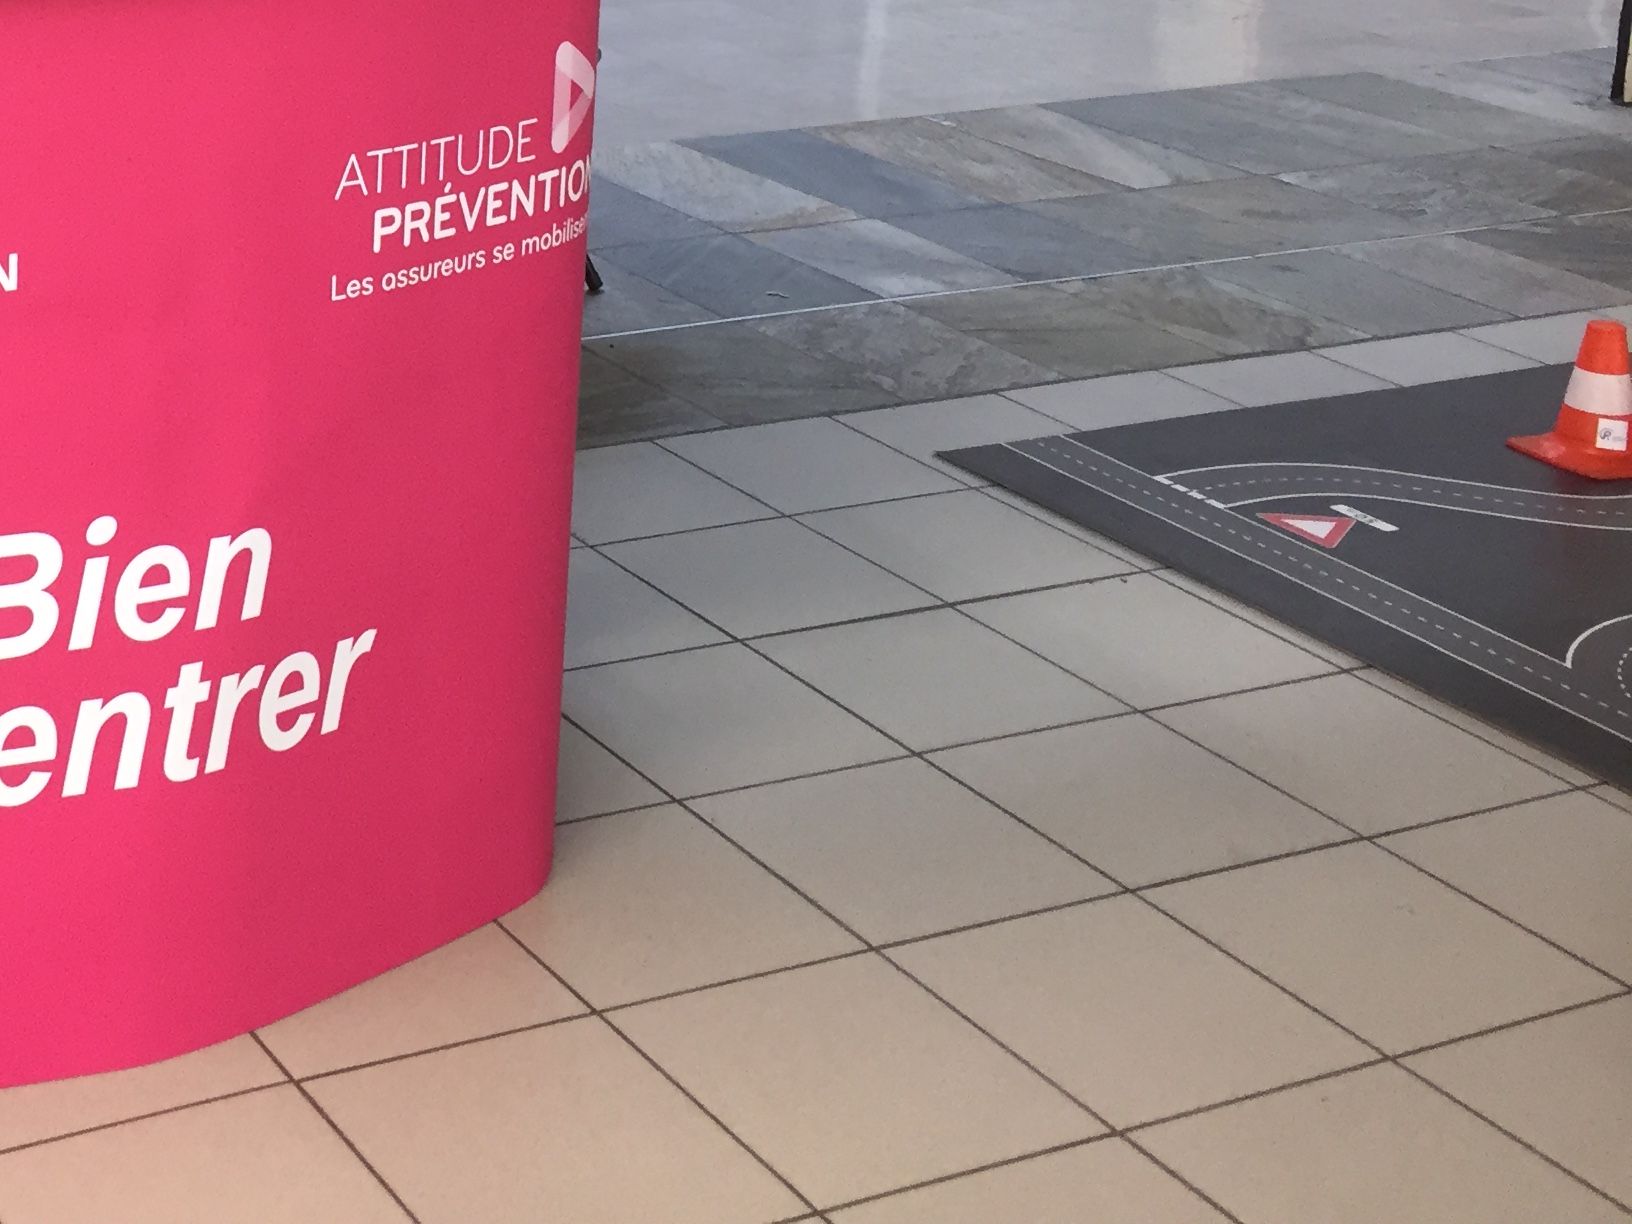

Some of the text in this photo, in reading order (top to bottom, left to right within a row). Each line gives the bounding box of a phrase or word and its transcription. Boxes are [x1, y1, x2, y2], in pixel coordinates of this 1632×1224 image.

[334, 117, 538, 201] ATTITUDE
[331, 274, 374, 302] Les
[381, 249, 486, 291] assureurs
[492, 242, 514, 265] se
